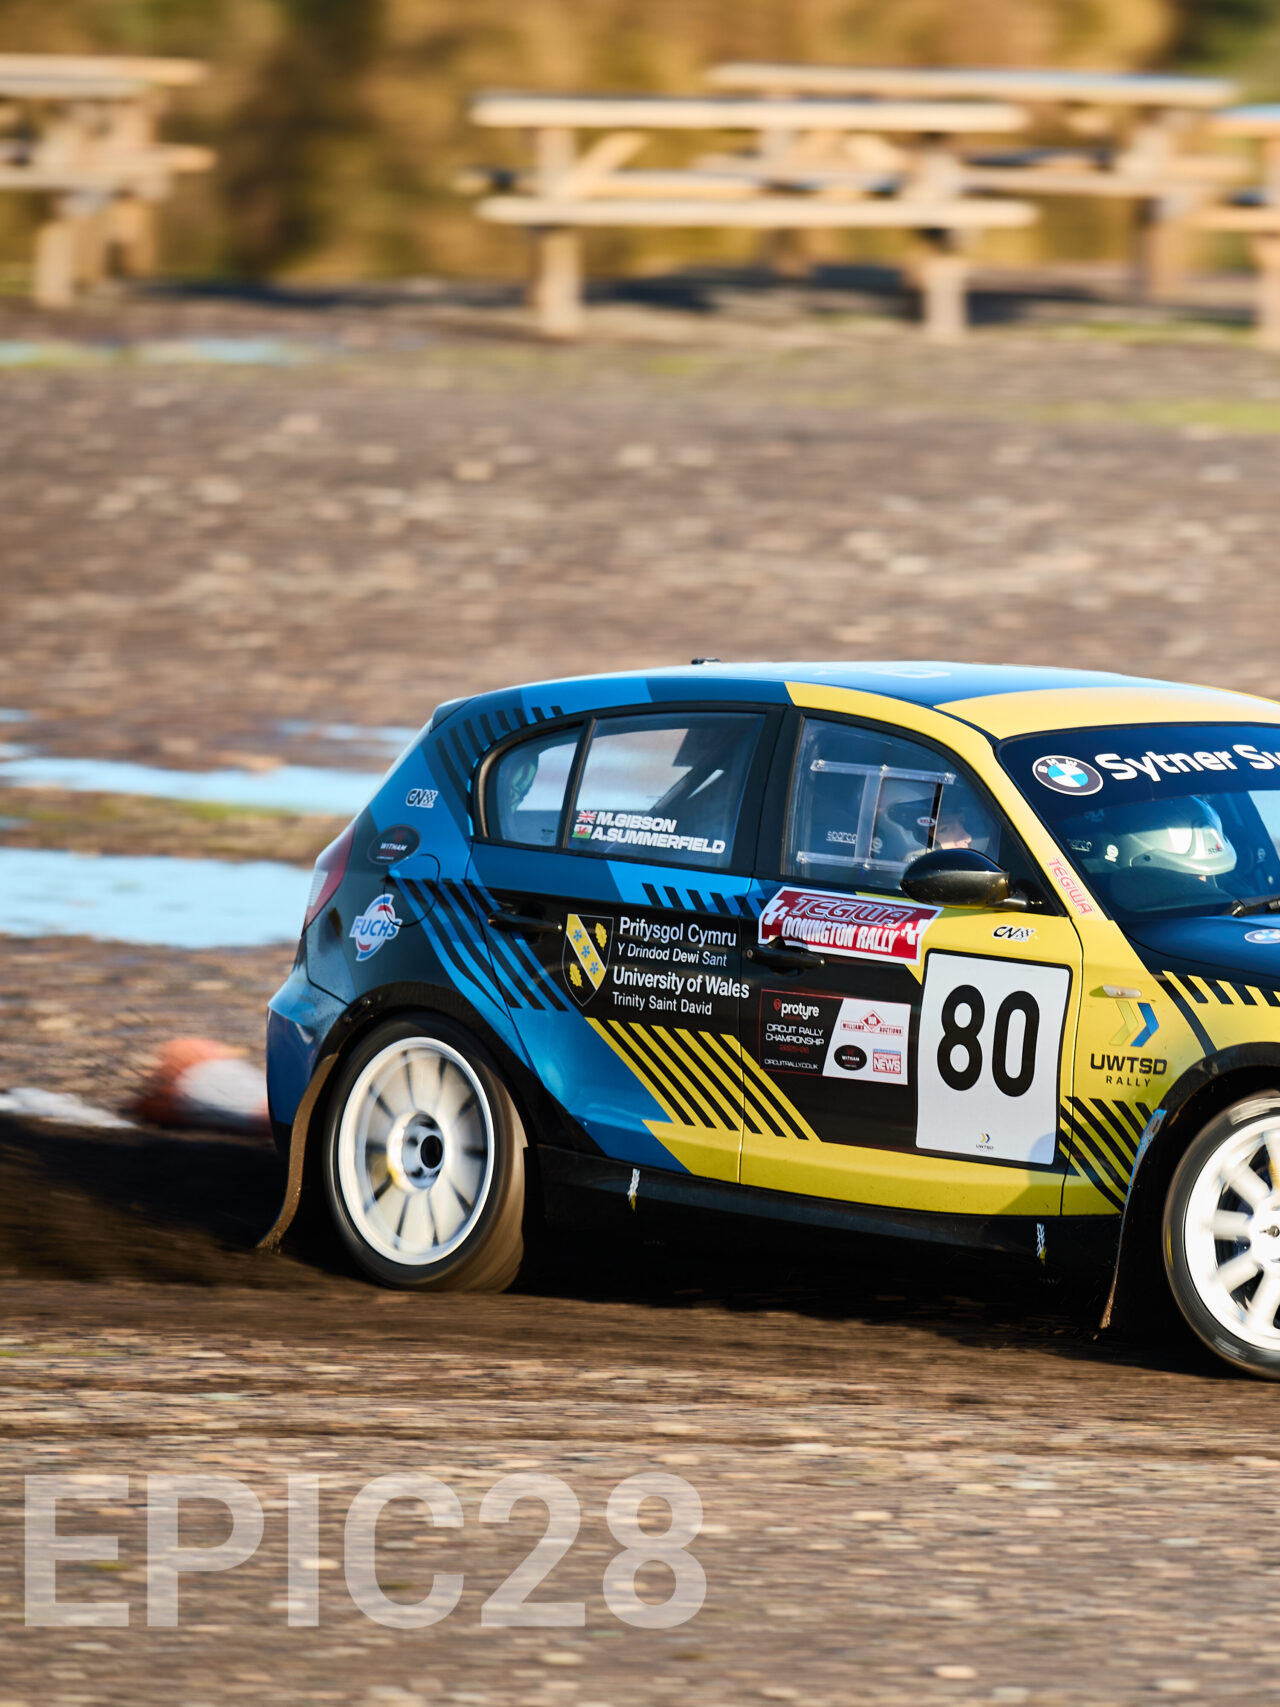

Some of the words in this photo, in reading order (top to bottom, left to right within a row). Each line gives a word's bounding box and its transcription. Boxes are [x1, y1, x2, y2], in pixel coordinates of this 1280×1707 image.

[1038, 757, 1077, 774] BMW
[1094, 751, 1238, 782] Sytner
[596, 811, 677, 833] M.GIBSON
[591, 826, 726, 854] A.SUMMERFIELD
[1046, 857, 1094, 915] TEGIWA
[790, 895, 917, 927] TEGIWA
[351, 918, 400, 939] FUCHS
[619, 916, 684, 944] Prifysgol
[687, 923, 738, 948] Cymru
[855, 924, 900, 953] RALLY
[617, 942, 626, 955] Y
[628, 943, 670, 961] Drindod
[672, 948, 700, 964] Dewi
[702, 951, 728, 967] Sant
[613, 965, 685, 996] University
[686, 974, 703, 993] of
[705, 975, 750, 999] Wales
[612, 991, 646, 1011] Trinity
[649, 995, 677, 1012] Saint
[681, 999, 713, 1016] David
[780, 1002, 820, 1020] protyre
[765, 1032, 825, 1046] CHAMPIONSHIP
[766, 1023, 797, 1034] CIRCUIT
[798, 1026, 824, 1037] RALLY
[936, 983, 1040, 1098] 80
[873, 1056, 901, 1072] NEWS
[1090, 1052, 1168, 1076] UWTSD
[1105, 1074, 1152, 1088] RALLY
